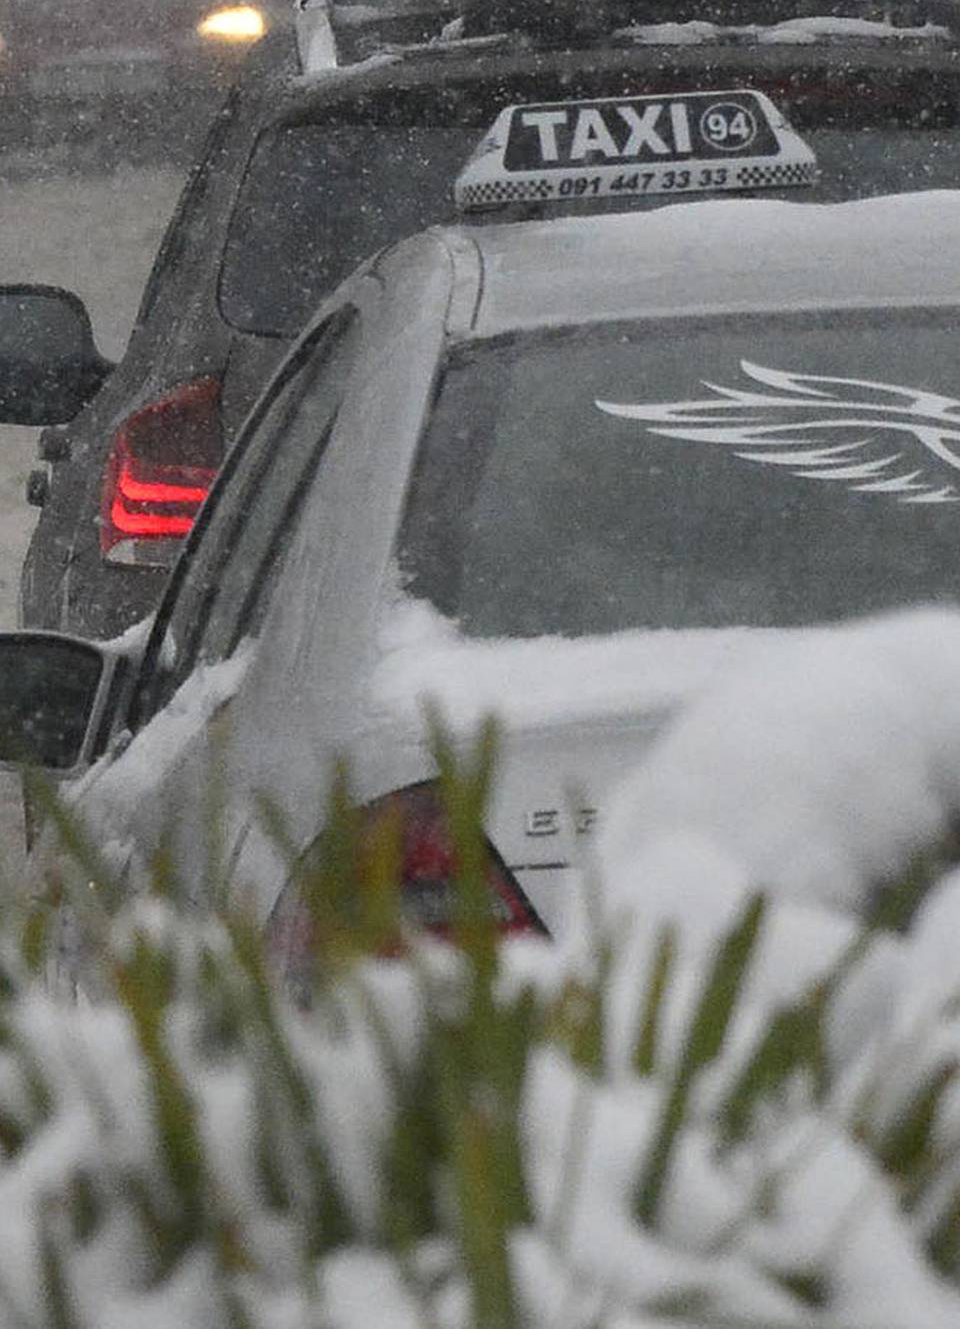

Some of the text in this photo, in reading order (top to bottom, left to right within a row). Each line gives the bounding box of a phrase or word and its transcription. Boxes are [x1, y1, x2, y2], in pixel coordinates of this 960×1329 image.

[521, 102, 749, 162] TAXI 94
[559, 168, 728, 196] 091 447 33 33
